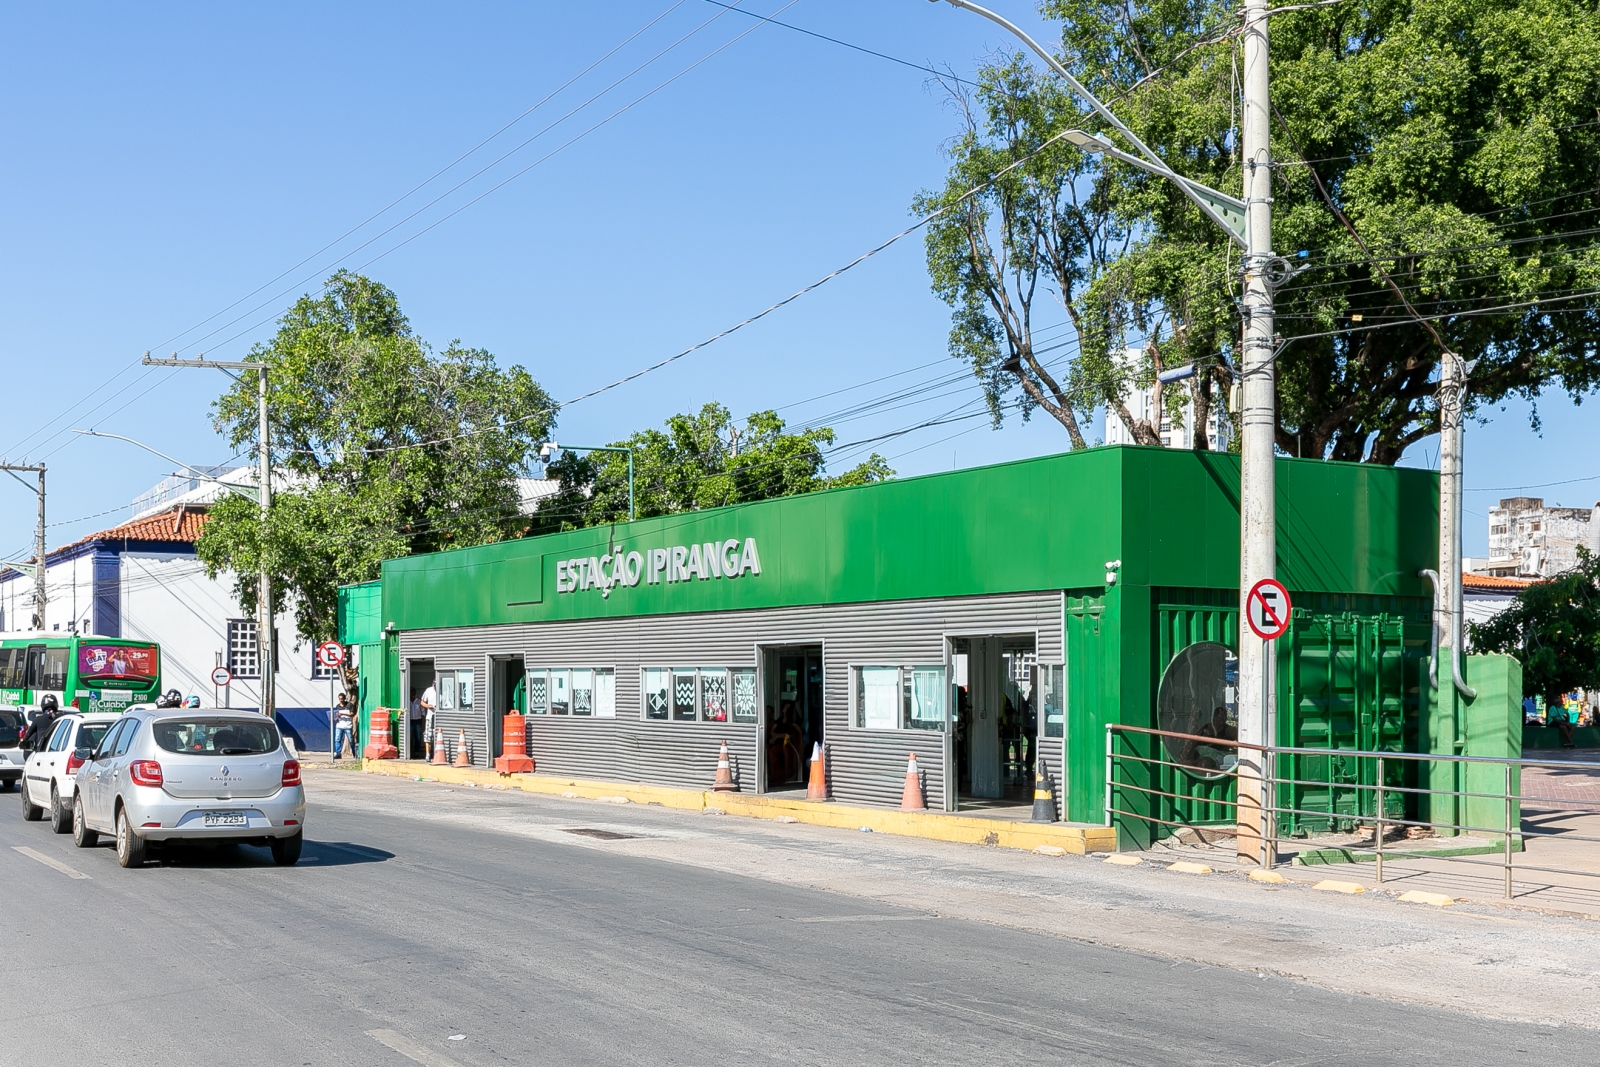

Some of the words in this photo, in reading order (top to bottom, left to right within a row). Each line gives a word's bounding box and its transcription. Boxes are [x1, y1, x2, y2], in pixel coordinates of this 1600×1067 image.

[556, 545, 644, 599] ESTAÇÃO
[646, 537, 762, 583] IPIRANGA
[88, 654, 106, 664] BEAT
[134, 693, 148, 701] 2100
